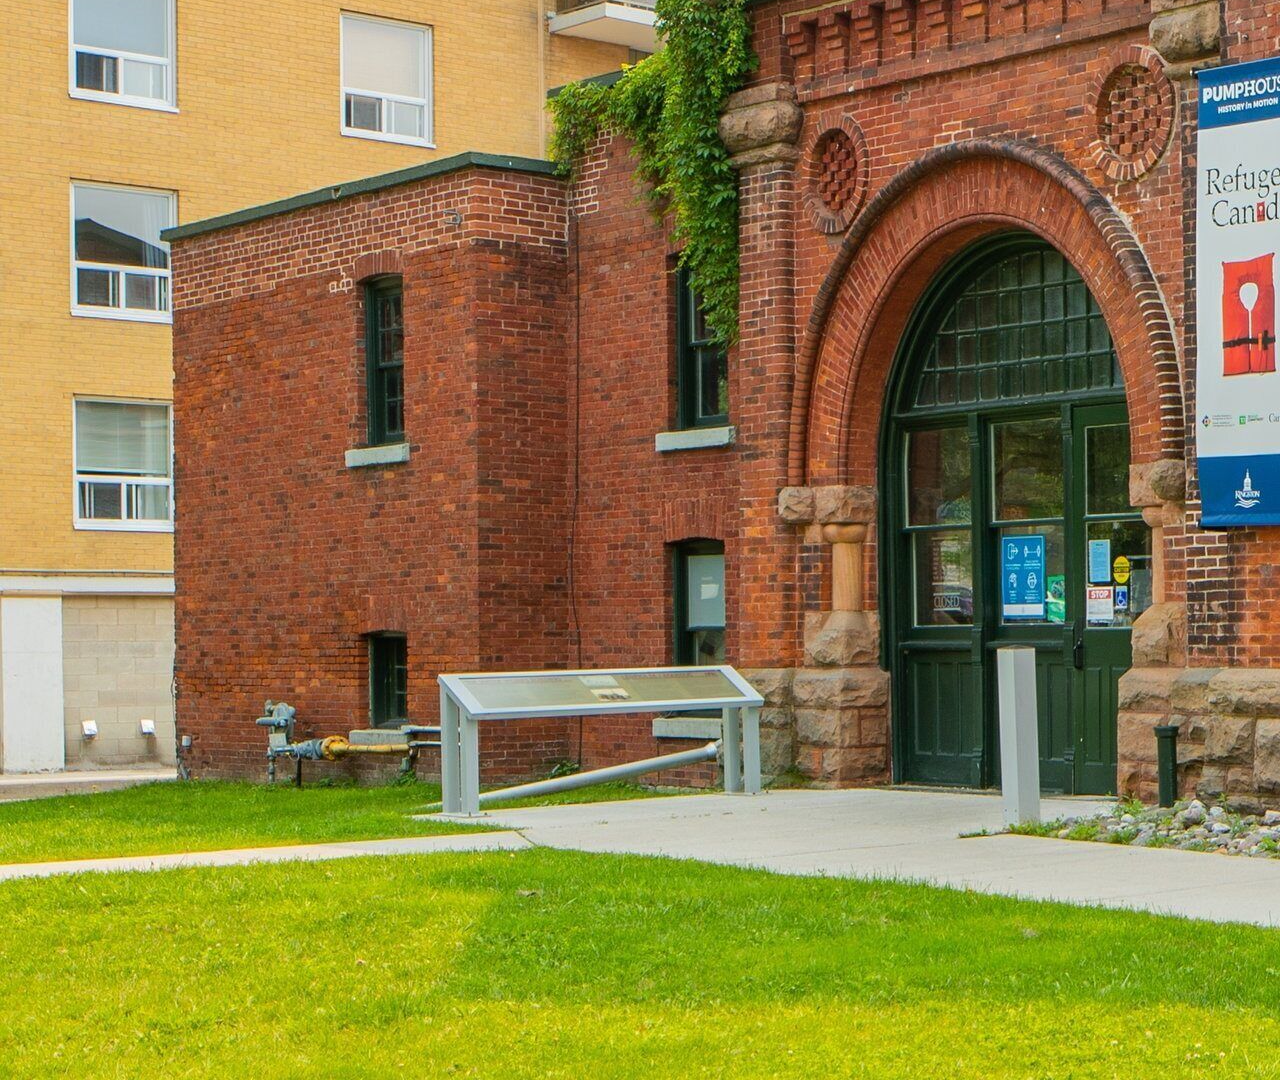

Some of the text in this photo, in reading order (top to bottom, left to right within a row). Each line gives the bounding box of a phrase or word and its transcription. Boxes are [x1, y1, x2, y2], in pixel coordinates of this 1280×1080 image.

[1217, 97, 1279, 114] HISTORY in MOTION
[1090, 590, 1109, 599] STOP
